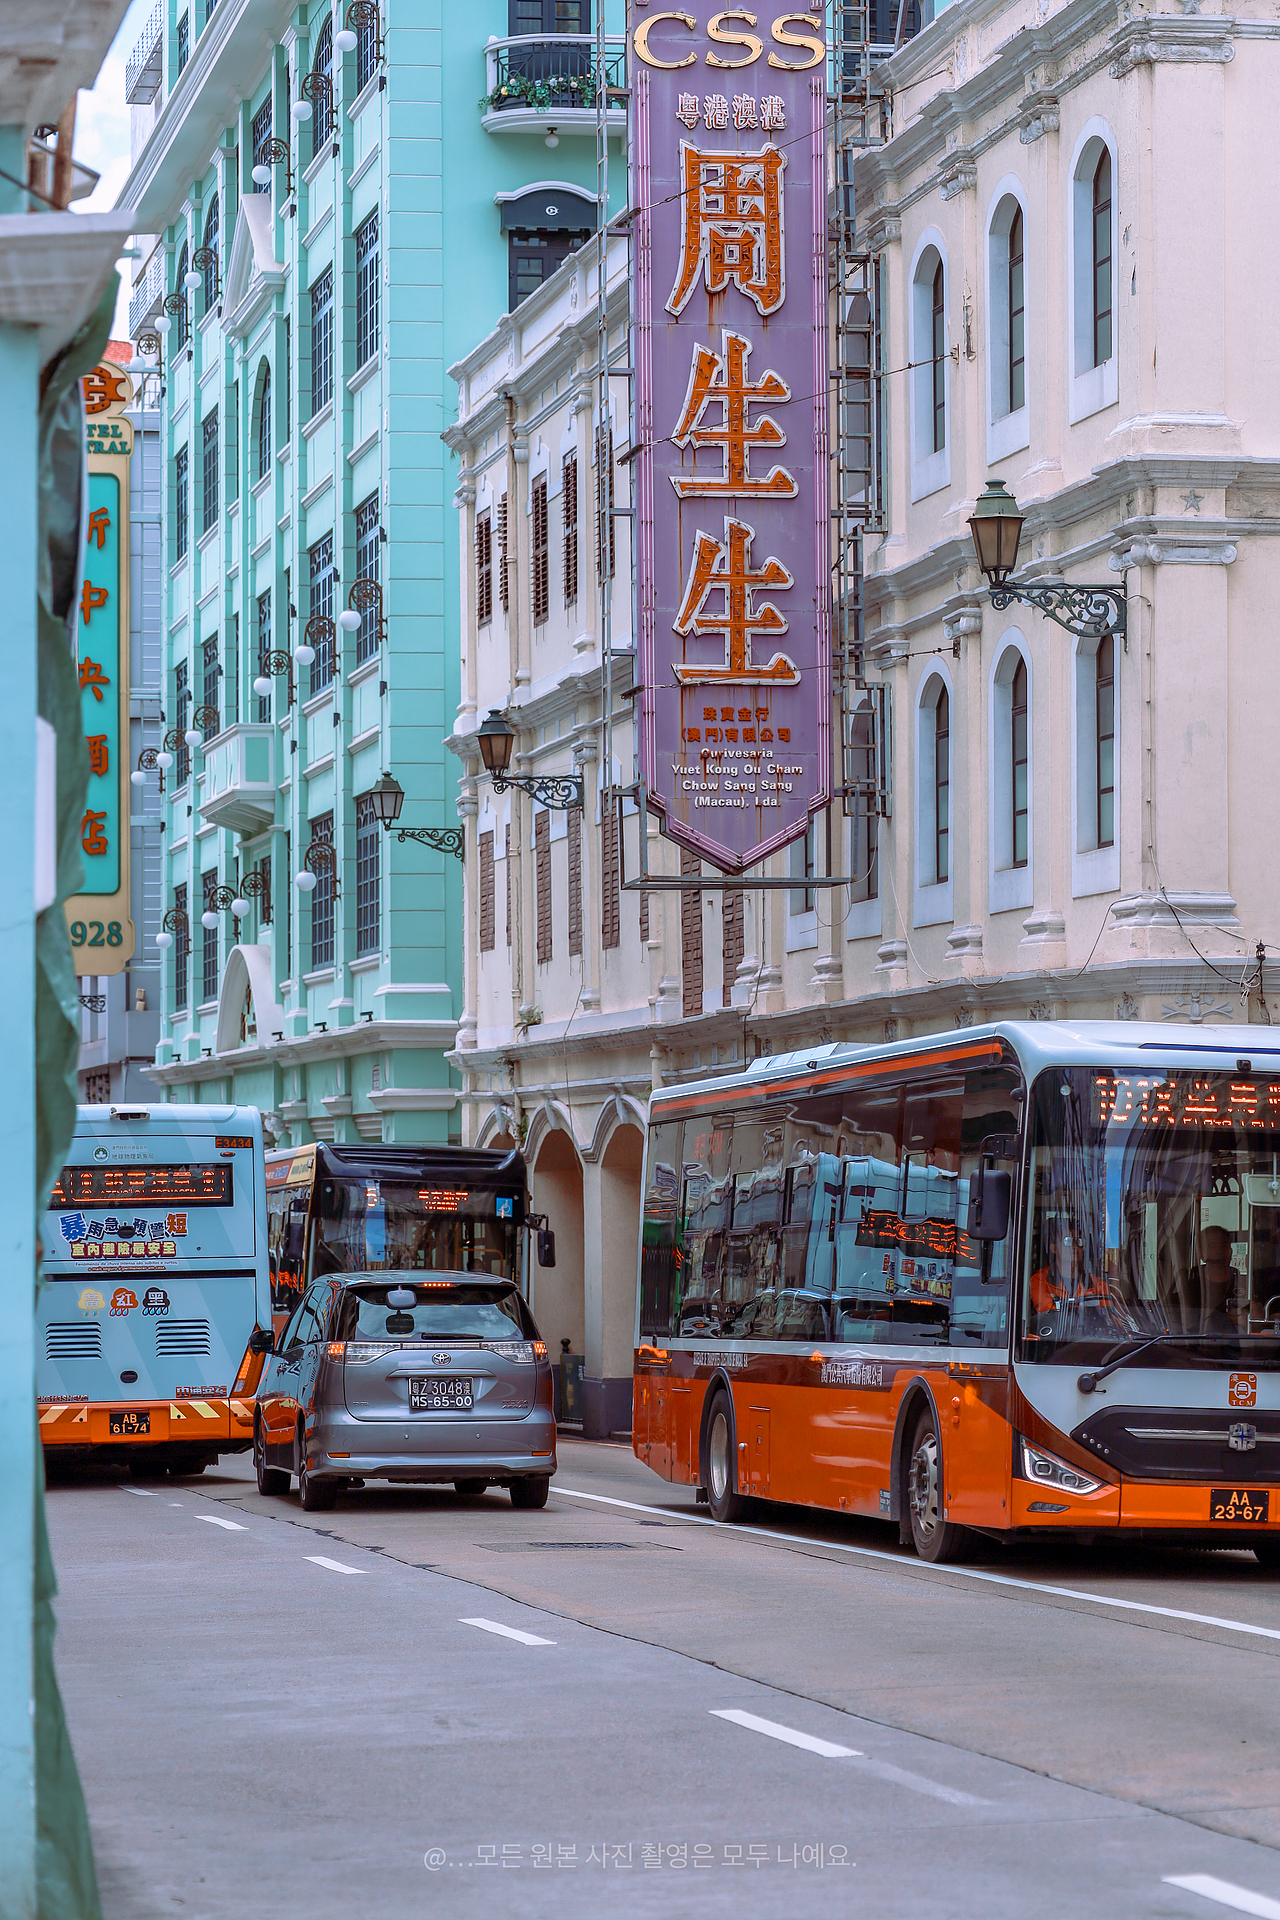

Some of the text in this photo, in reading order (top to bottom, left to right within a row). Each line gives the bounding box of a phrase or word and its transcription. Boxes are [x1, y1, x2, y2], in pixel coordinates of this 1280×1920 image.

[633, 10, 826, 70] CSS
[663, 138, 803, 687] 周生生
[86, 423, 123, 438] TEL
[86, 440, 132, 455] TRAL
[703, 706, 770, 722] 珠寶金行
[681, 727, 791, 743] (澳門)有限公司
[700, 748, 773, 759] Ourivesaria
[672, 764, 803, 777] Yuet Kong Ou Cham
[682, 780, 793, 793] Chow Sang Sang
[694, 796, 781, 808] (Macau), Lda.
[70, 921, 123, 947] 928
[216, 1137, 252, 1148] E3434
[115, 1291, 134, 1307] 紅
[147, 1292, 166, 1306] 黑
[411, 1395, 473, 1407] MS-65-00
[123, 1414, 137, 1423] AB
[113, 1423, 147, 1434] 61-74
[1230, 1491, 1250, 1505] AA
[1214, 1506, 1264, 1521] 23-67
